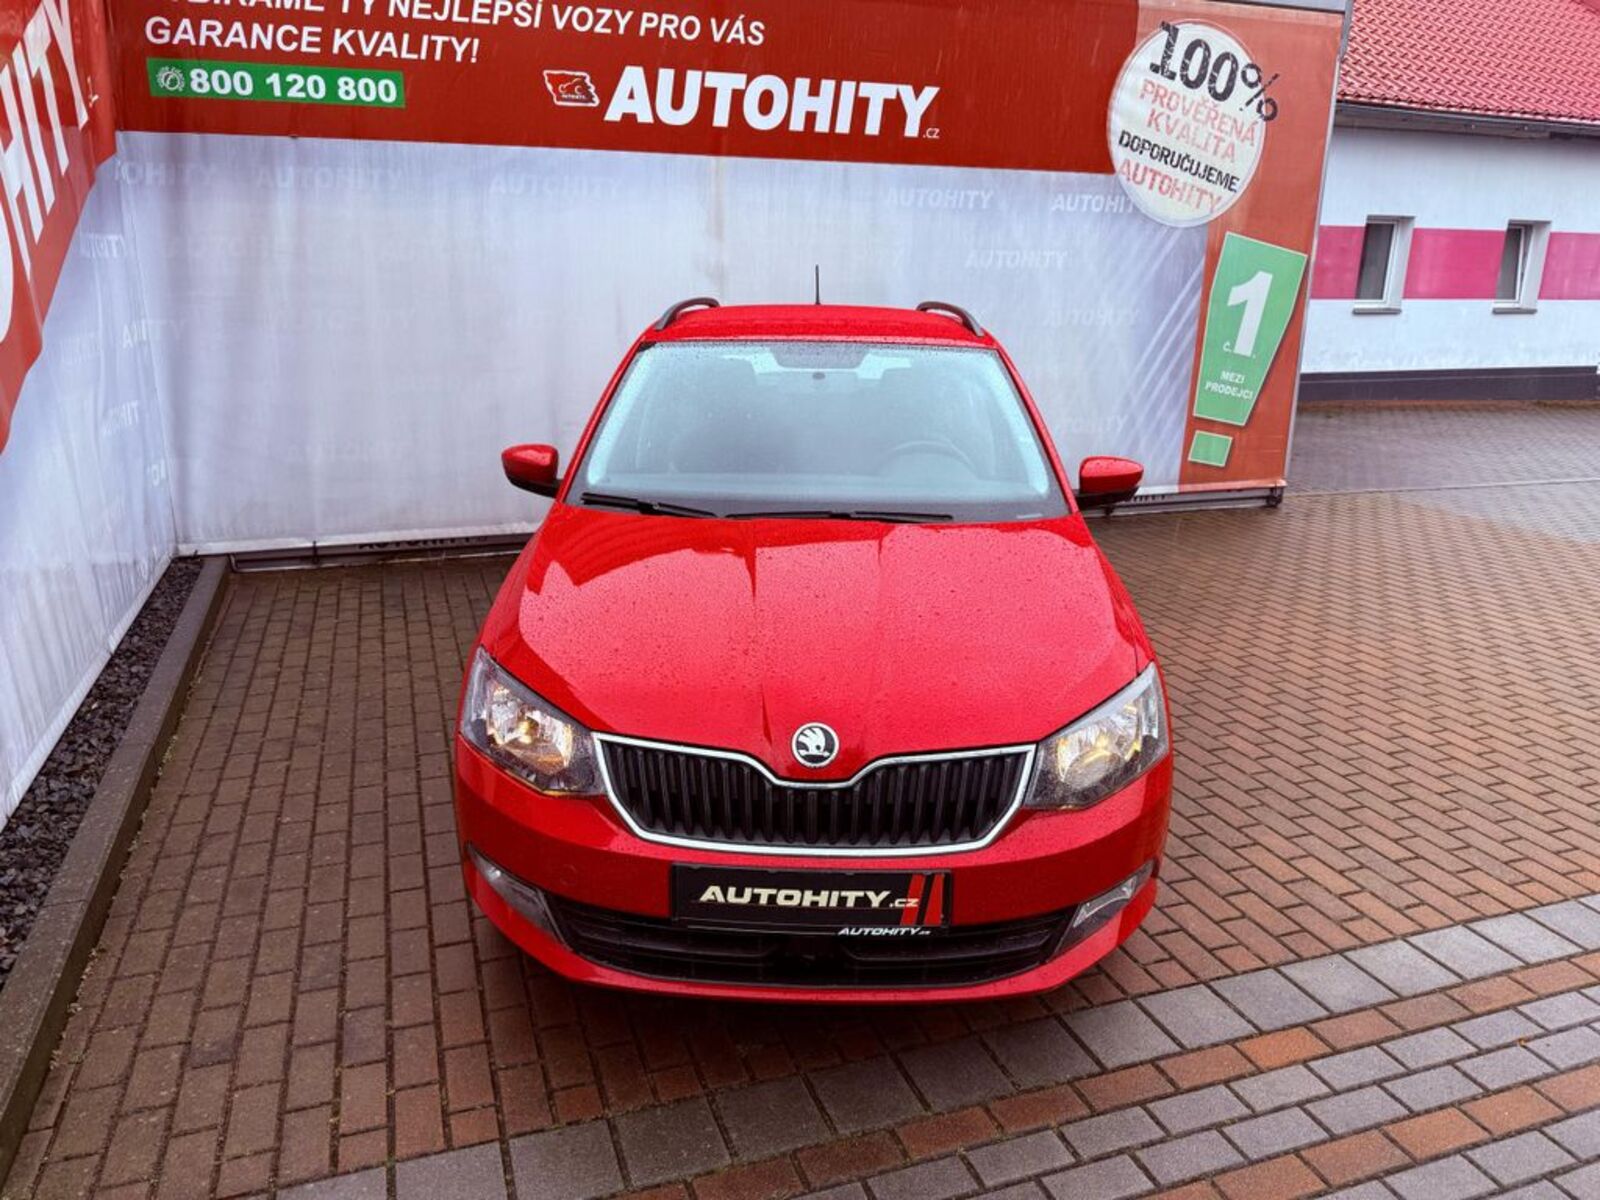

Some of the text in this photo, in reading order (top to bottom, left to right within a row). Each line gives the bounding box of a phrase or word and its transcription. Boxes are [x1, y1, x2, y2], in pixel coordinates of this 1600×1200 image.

[144, 16, 480, 63] GARANCE KVALITY!
[551, 4, 634, 35] VOZY
[639, 12, 701, 41] PRO
[709, 14, 765, 46] VÁS
[189, 68, 253, 96] 800
[265, 72, 326, 100] 120
[337, 75, 397, 104] 800
[1150, 21, 1279, 121] 100%
[1139, 79, 1259, 147] PROVĚŘENÁ
[1147, 109, 1237, 163] KVALITA
[0, 0, 88, 343] HITY
[1118, 130, 1241, 193] DOPORUČUJEME
[1120, 159, 1222, 214] AUTOHITY
[887, 187, 994, 210] AUTOHITY
[1204, 381, 1253, 399] PRODEJCI
[1220, 370, 1246, 384] MEZI
